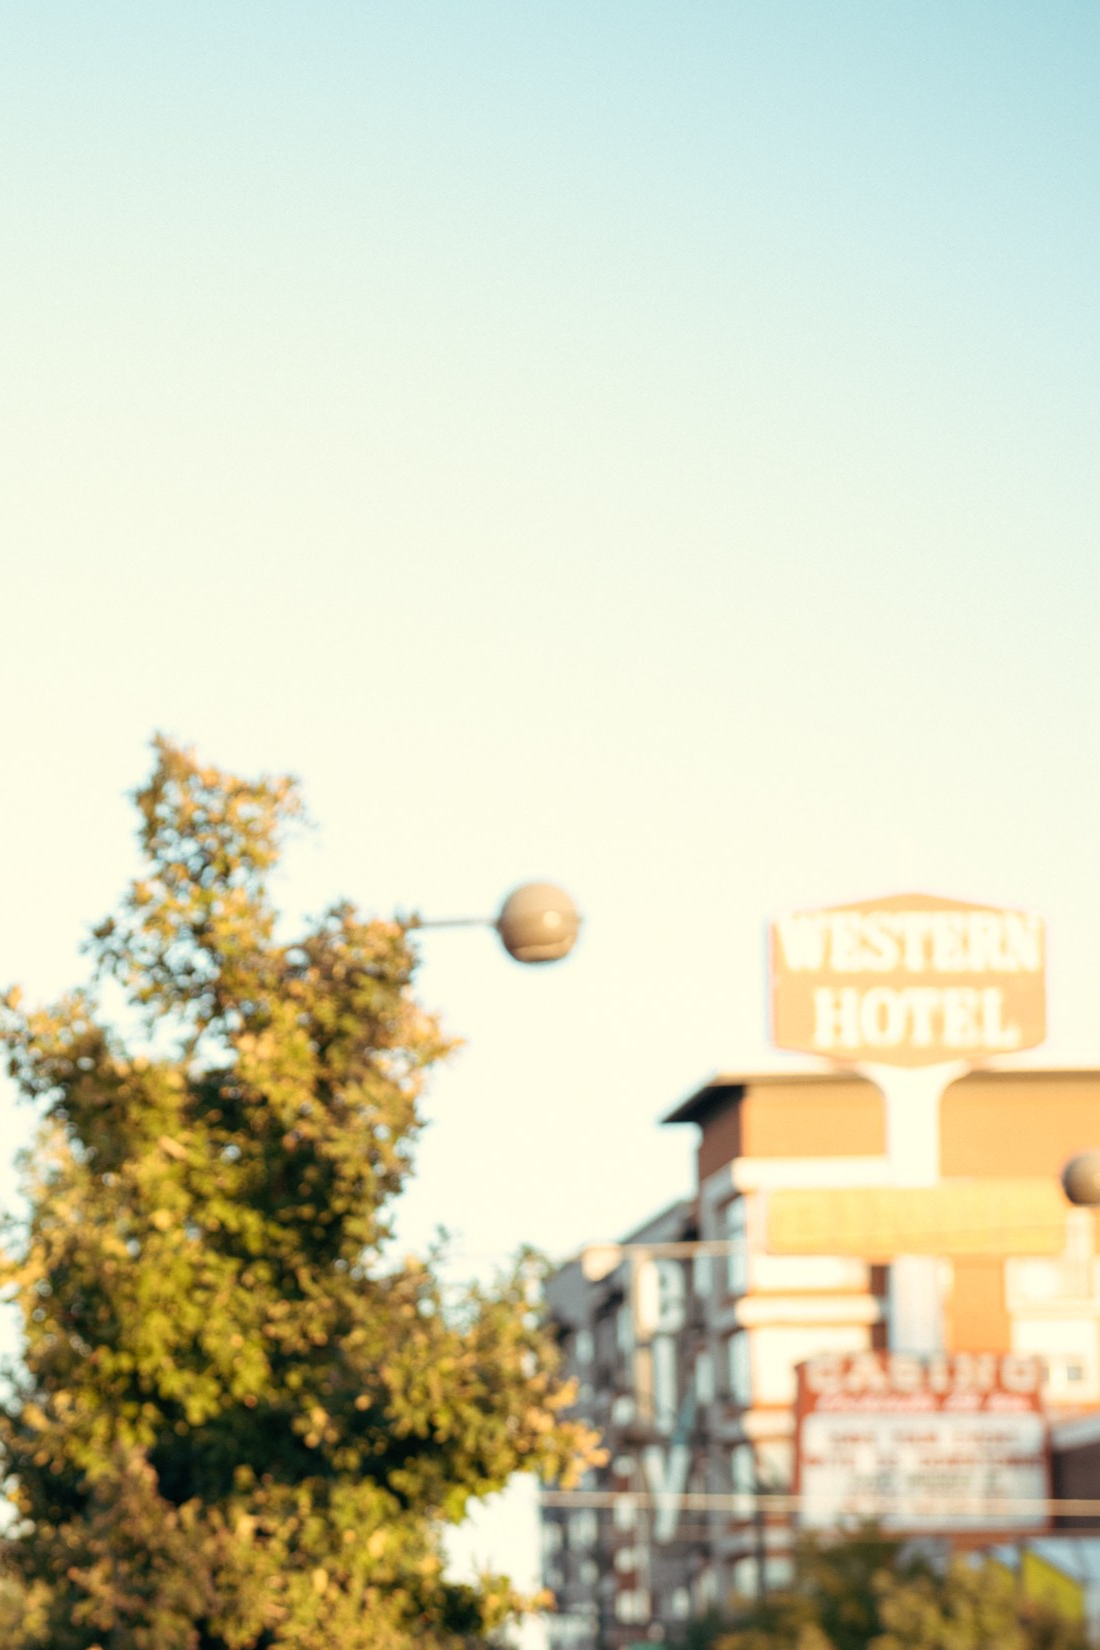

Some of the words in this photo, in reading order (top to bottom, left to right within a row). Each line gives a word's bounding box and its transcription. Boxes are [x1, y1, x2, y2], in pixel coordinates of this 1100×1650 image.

[775, 910, 1043, 973] WESTERN
[812, 985, 1022, 1048] HOTEL
[803, 1350, 1043, 1396] CASINO
